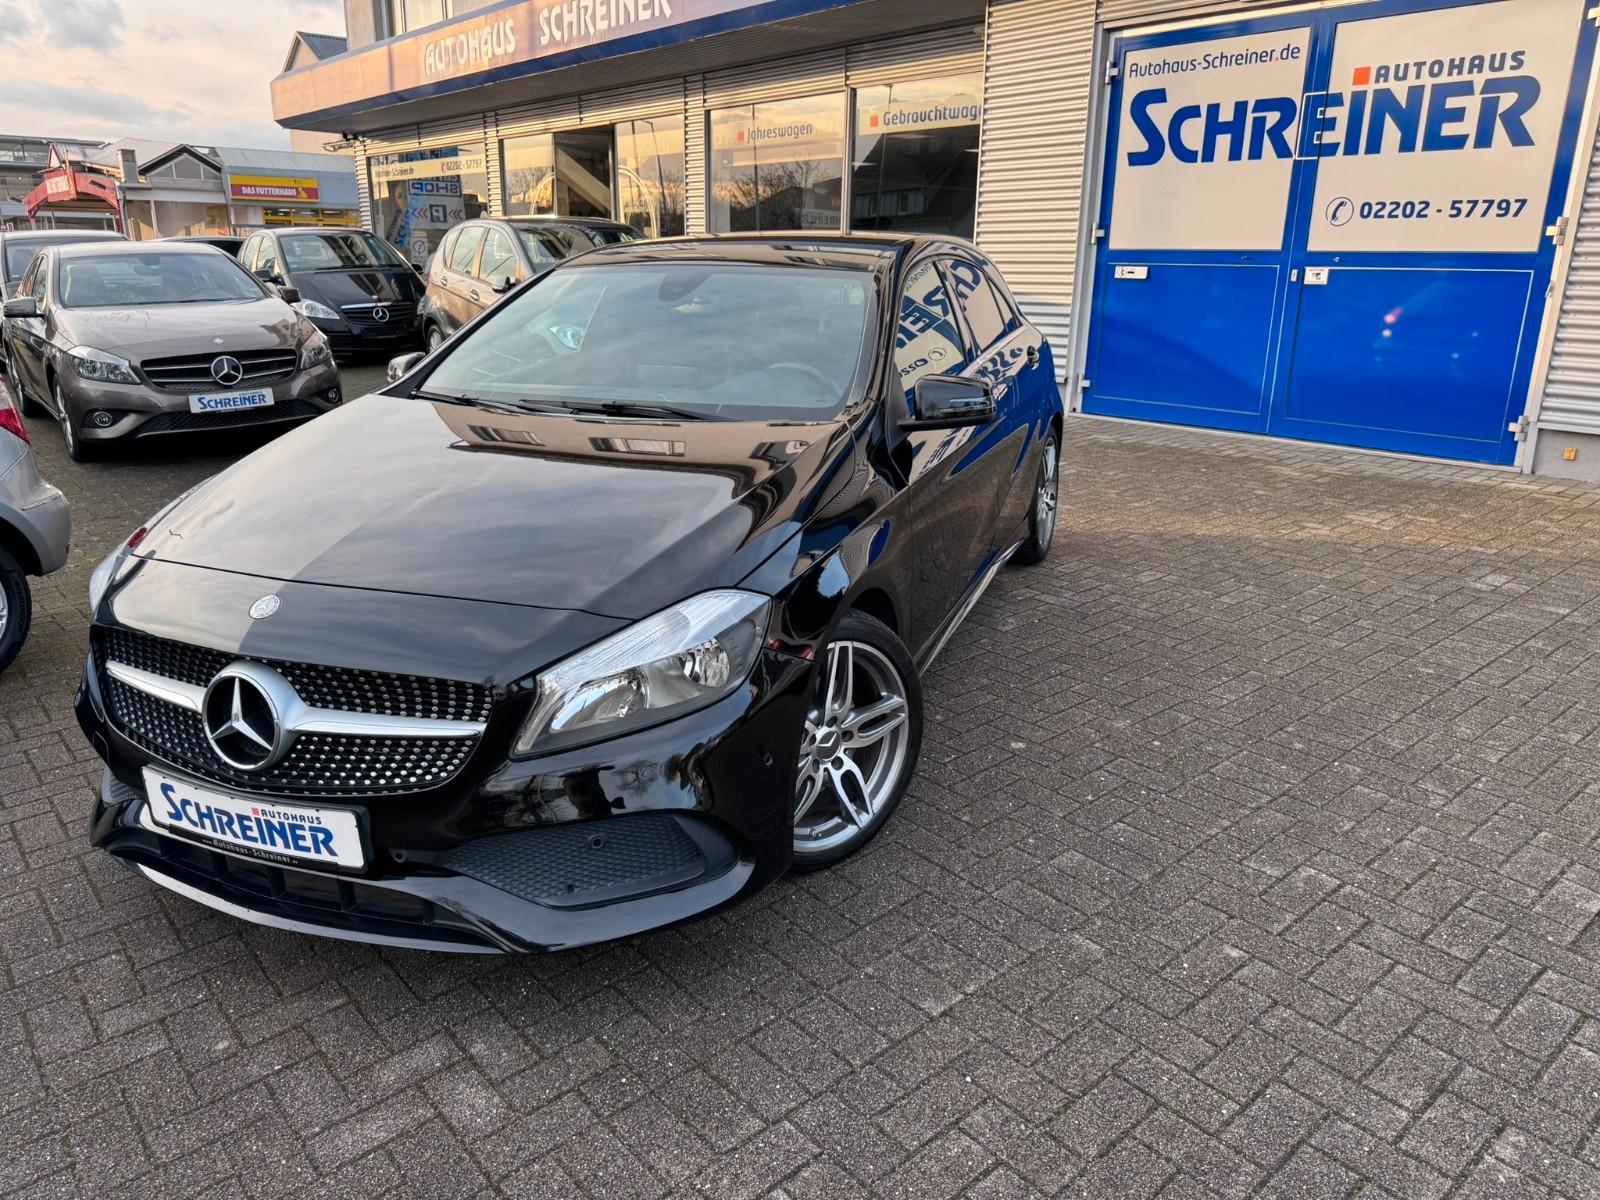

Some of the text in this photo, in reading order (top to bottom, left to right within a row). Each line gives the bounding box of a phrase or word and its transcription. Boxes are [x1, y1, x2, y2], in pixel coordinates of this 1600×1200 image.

[424, 19, 516, 75] AUTOHAUS
[1129, 43, 1301, 79] Autohaus-Schreiner.de
[1374, 50, 1526, 83] AUTOHAUS
[747, 123, 813, 144] Jahreswagen
[1127, 74, 1541, 167] SCHREINER
[242, 186, 255, 194] DAS
[1360, 200, 1430, 219] 02202
[1448, 198, 1528, 218] 57797
[197, 394, 267, 410] SCHREINER
[160, 782, 339, 858] SCHREINER
[261, 809, 322, 825] AUTOHAUS
